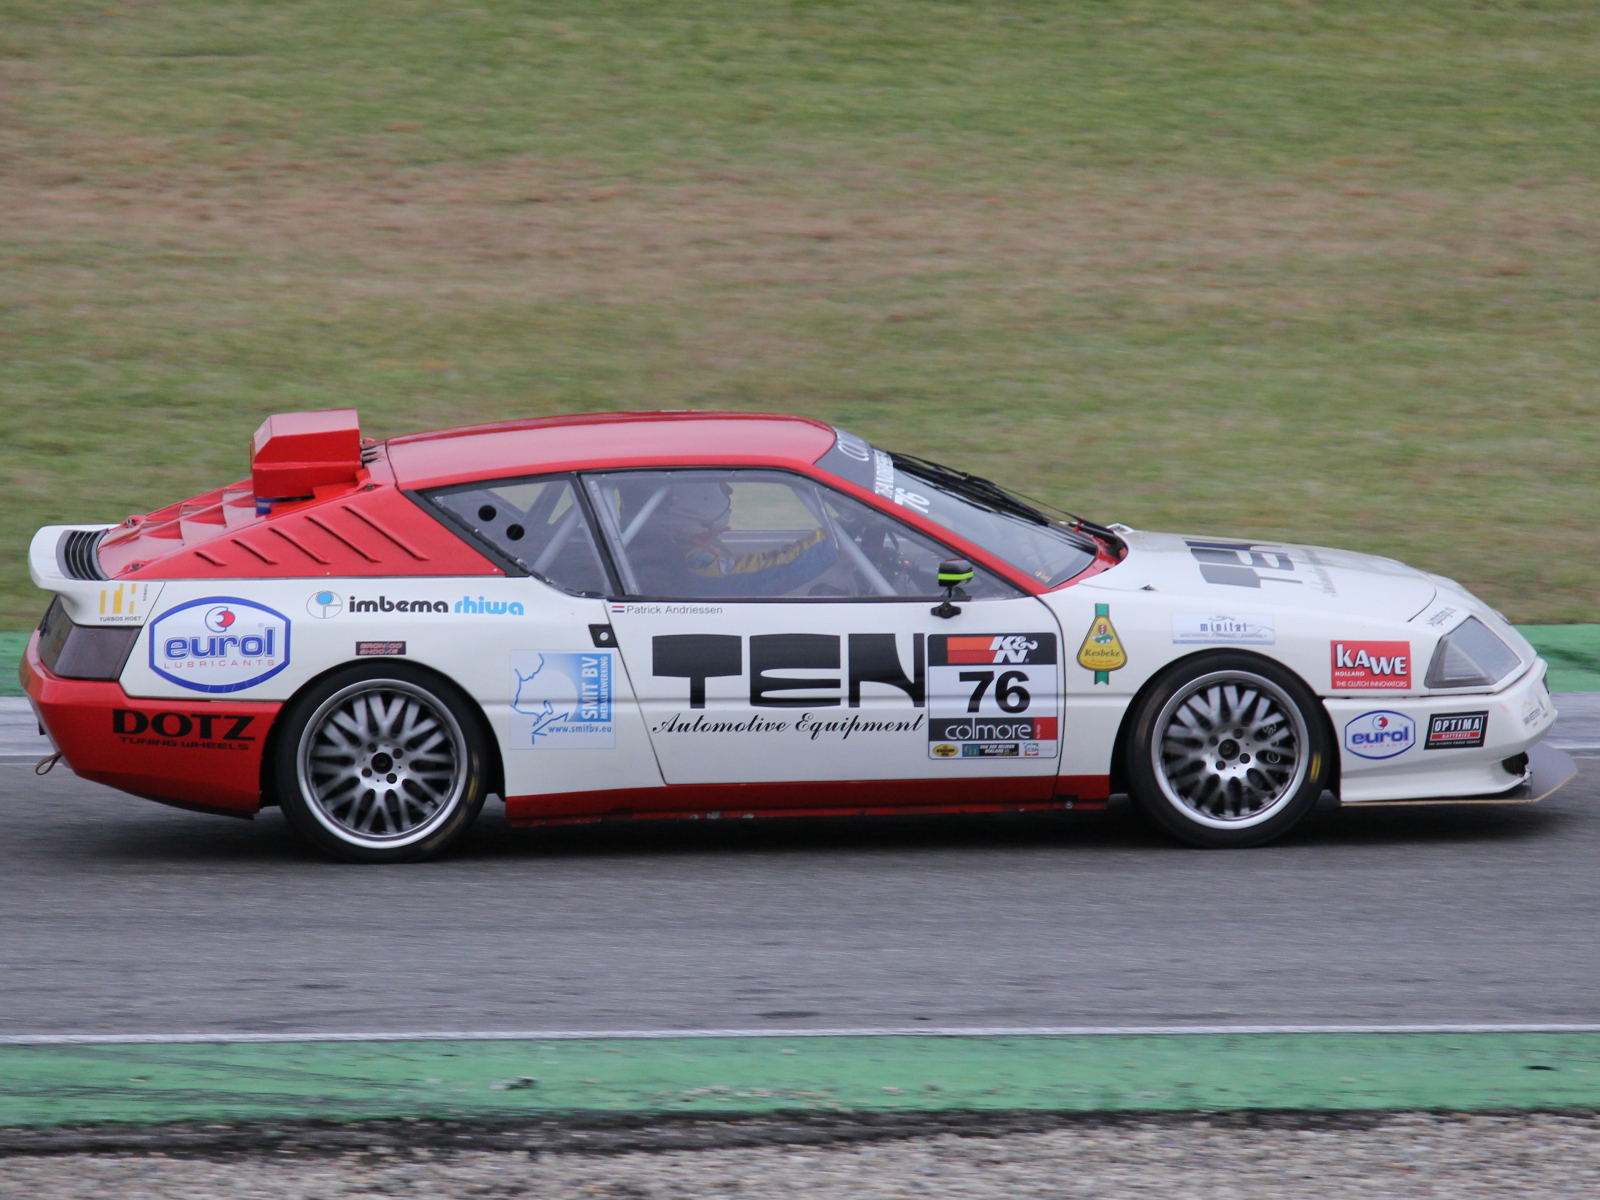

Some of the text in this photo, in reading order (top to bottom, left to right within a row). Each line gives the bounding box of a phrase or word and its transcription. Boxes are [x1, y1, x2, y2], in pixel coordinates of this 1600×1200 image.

[349, 596, 524, 616] imbema rhiwa
[626, 604, 723, 615] Patrick Andriessen
[164, 627, 276, 660] eurol
[1084, 649, 1121, 657] Kesbeke
[164, 660, 275, 669] LUBRICANTS
[1335, 643, 1408, 676] KAWE
[652, 633, 925, 709] TEN
[582, 656, 599, 719] SMIT BV
[959, 670, 1031, 713] 76
[112, 708, 256, 741] DOTZ
[548, 723, 612, 734] www.smitbv.eu
[652, 712, 925, 740] Automotive Equipment
[945, 718, 1032, 740] colmore
[1434, 718, 1481, 732] OPTIMA
[118, 736, 250, 750] TUNING WHEELS
[1351, 726, 1409, 745] eurol
